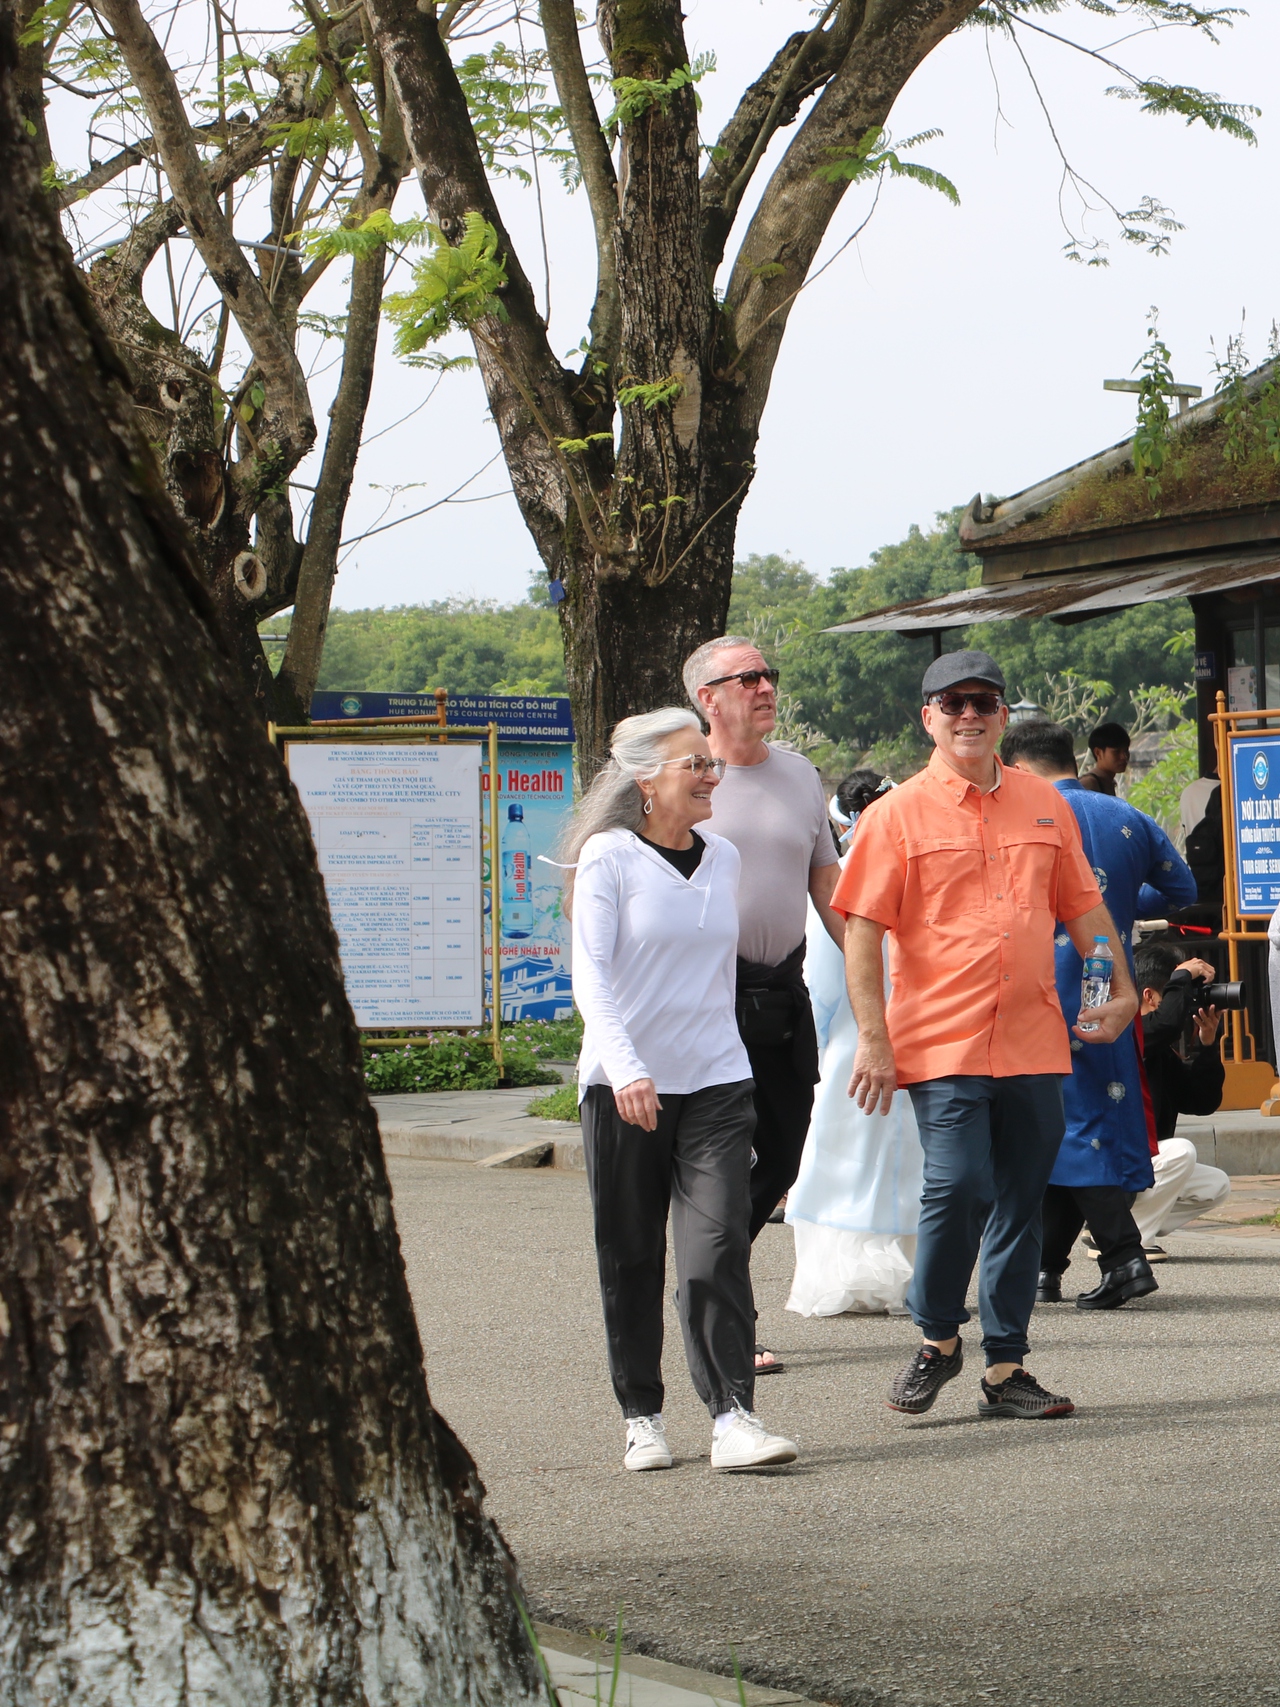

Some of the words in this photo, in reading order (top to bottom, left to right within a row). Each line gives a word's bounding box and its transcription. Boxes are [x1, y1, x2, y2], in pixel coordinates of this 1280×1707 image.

[418, 698, 436, 706] TÂM
[489, 700, 508, 708] TÍCH
[526, 701, 539, 709] ĐÔ
[541, 701, 558, 710] HUẾ
[497, 726, 527, 734] ENDING
[529, 727, 569, 736] MACHINE
[508, 770, 563, 792] Health
[1241, 797, 1254, 821] NƠI
[1255, 794, 1272, 820] LIÊN
[513, 853, 524, 880] Health
